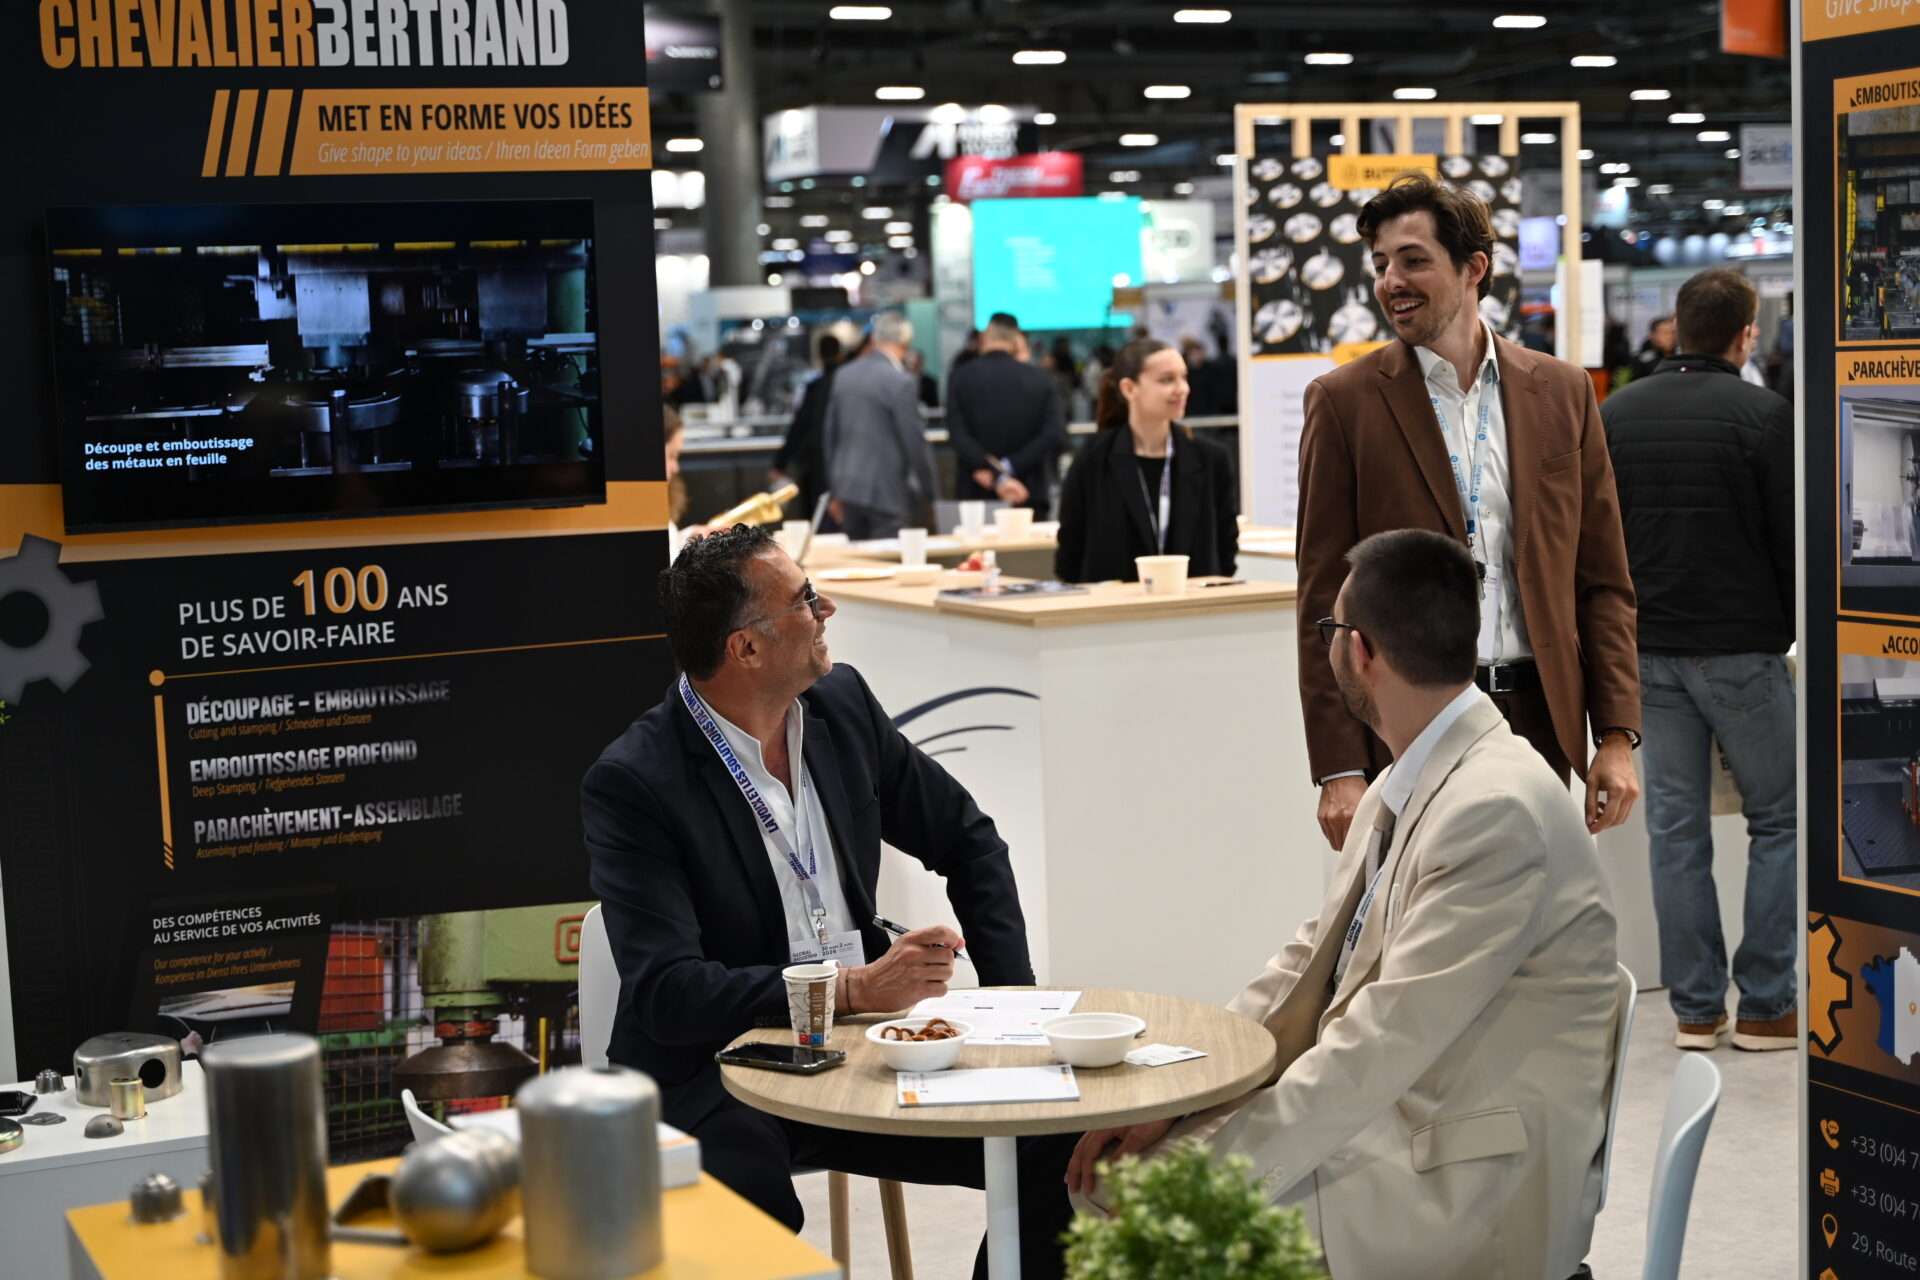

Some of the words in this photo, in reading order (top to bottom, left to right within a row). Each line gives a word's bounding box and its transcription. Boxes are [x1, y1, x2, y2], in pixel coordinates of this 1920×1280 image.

[1856, 80, 1920, 105] EMBOUTIS
[317, 104, 370, 132] MET
[380, 104, 413, 131] EN
[421, 102, 506, 130] FORME
[513, 102, 560, 129] VOS
[569, 96, 633, 129] IDÉES
[318, 142, 348, 163] Give
[351, 142, 392, 169] shape
[396, 143, 410, 162] to
[411, 144, 444, 172] your
[446, 140, 482, 160] ideas
[495, 139, 531, 160] Ihren
[534, 139, 571, 159] Ideen
[574, 138, 607, 158] Form
[608, 138, 649, 164] geben
[84, 442, 143, 456] Découpe
[145, 440, 160, 452] et
[162, 437, 254, 451] emboutissage
[85, 458, 109, 471] des
[112, 456, 163, 470] métaux
[166, 456, 183, 467] en
[185, 452, 227, 467] feuille
[179, 599, 245, 626] PLUS
[252, 596, 286, 620] DE
[292, 564, 389, 616] 100
[397, 583, 449, 609] ANS
[181, 635, 216, 660] DE
[221, 620, 396, 657] SAVOIR-FAIRE
[187, 694, 296, 725] DÉCOUPAGE
[314, 679, 451, 713] EMBOUTISSAGE
[189, 724, 219, 741] Cutting
[220, 723, 237, 737] and
[238, 720, 277, 736] stamping
[190, 748, 331, 782] EMBOUTISSAGE
[334, 739, 418, 768] PROFOND
[192, 784, 215, 798] Deep
[153, 916, 175, 930] DES
[177, 906, 262, 927] COMPÉTENCES
[153, 932, 171, 945] AU
[173, 926, 219, 942] SERVICE
[222, 923, 238, 937] DE
[239, 920, 264, 933] VOS
[265, 912, 321, 931] ACTIVITÉS
[1850, 1135, 1877, 1157] +33
[1879, 1142, 1907, 1167] (0)4
[1850, 1185, 1877, 1207] +33
[1879, 1192, 1907, 1217] (0)4
[1851, 1231, 1873, 1257] 29,
[1876, 1240, 1918, 1272] Route
